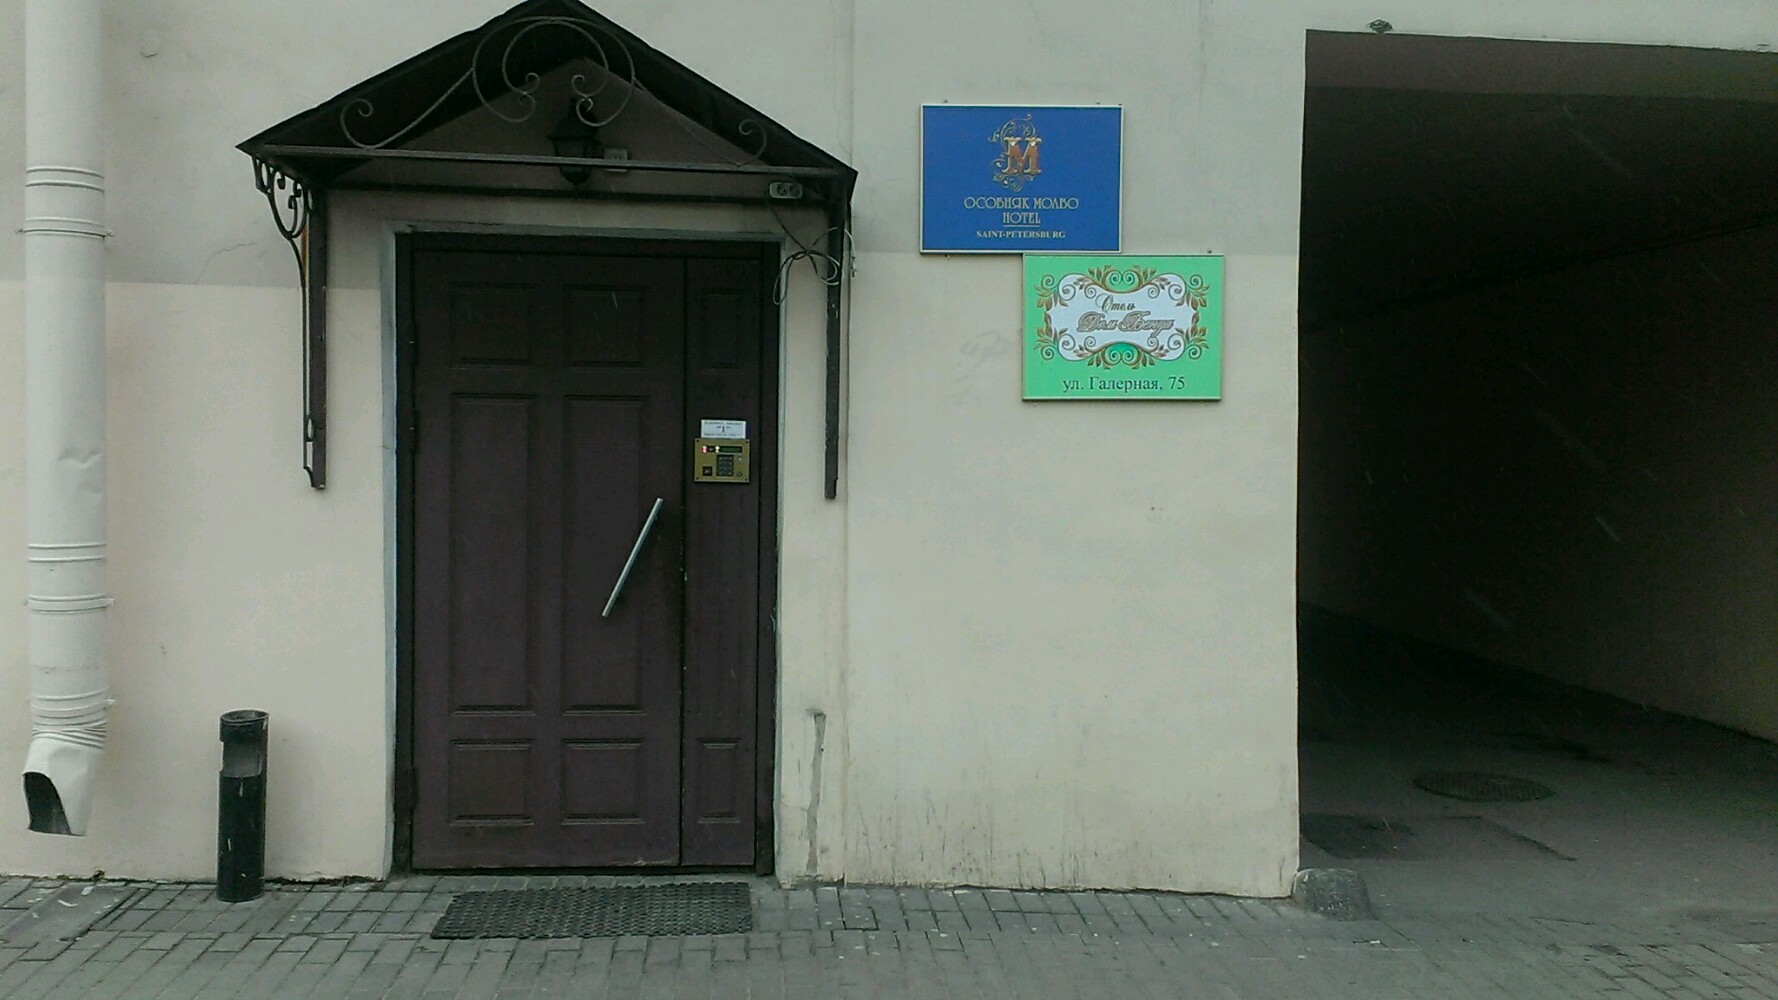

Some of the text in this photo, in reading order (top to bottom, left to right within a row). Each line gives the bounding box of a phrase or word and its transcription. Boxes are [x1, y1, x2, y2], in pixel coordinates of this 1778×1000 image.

[964, 196, 1079, 209] ОСОБНЯК МОЛВО
[1002, 212, 1040, 224] HOTEL
[976, 230, 1066, 239] SAINT-PETERSBURG
[1095, 293, 1136, 312] Отель
[1077, 311, 1119, 333] Дом
[1063, 376, 1185, 393] ул. Галерная, 75
